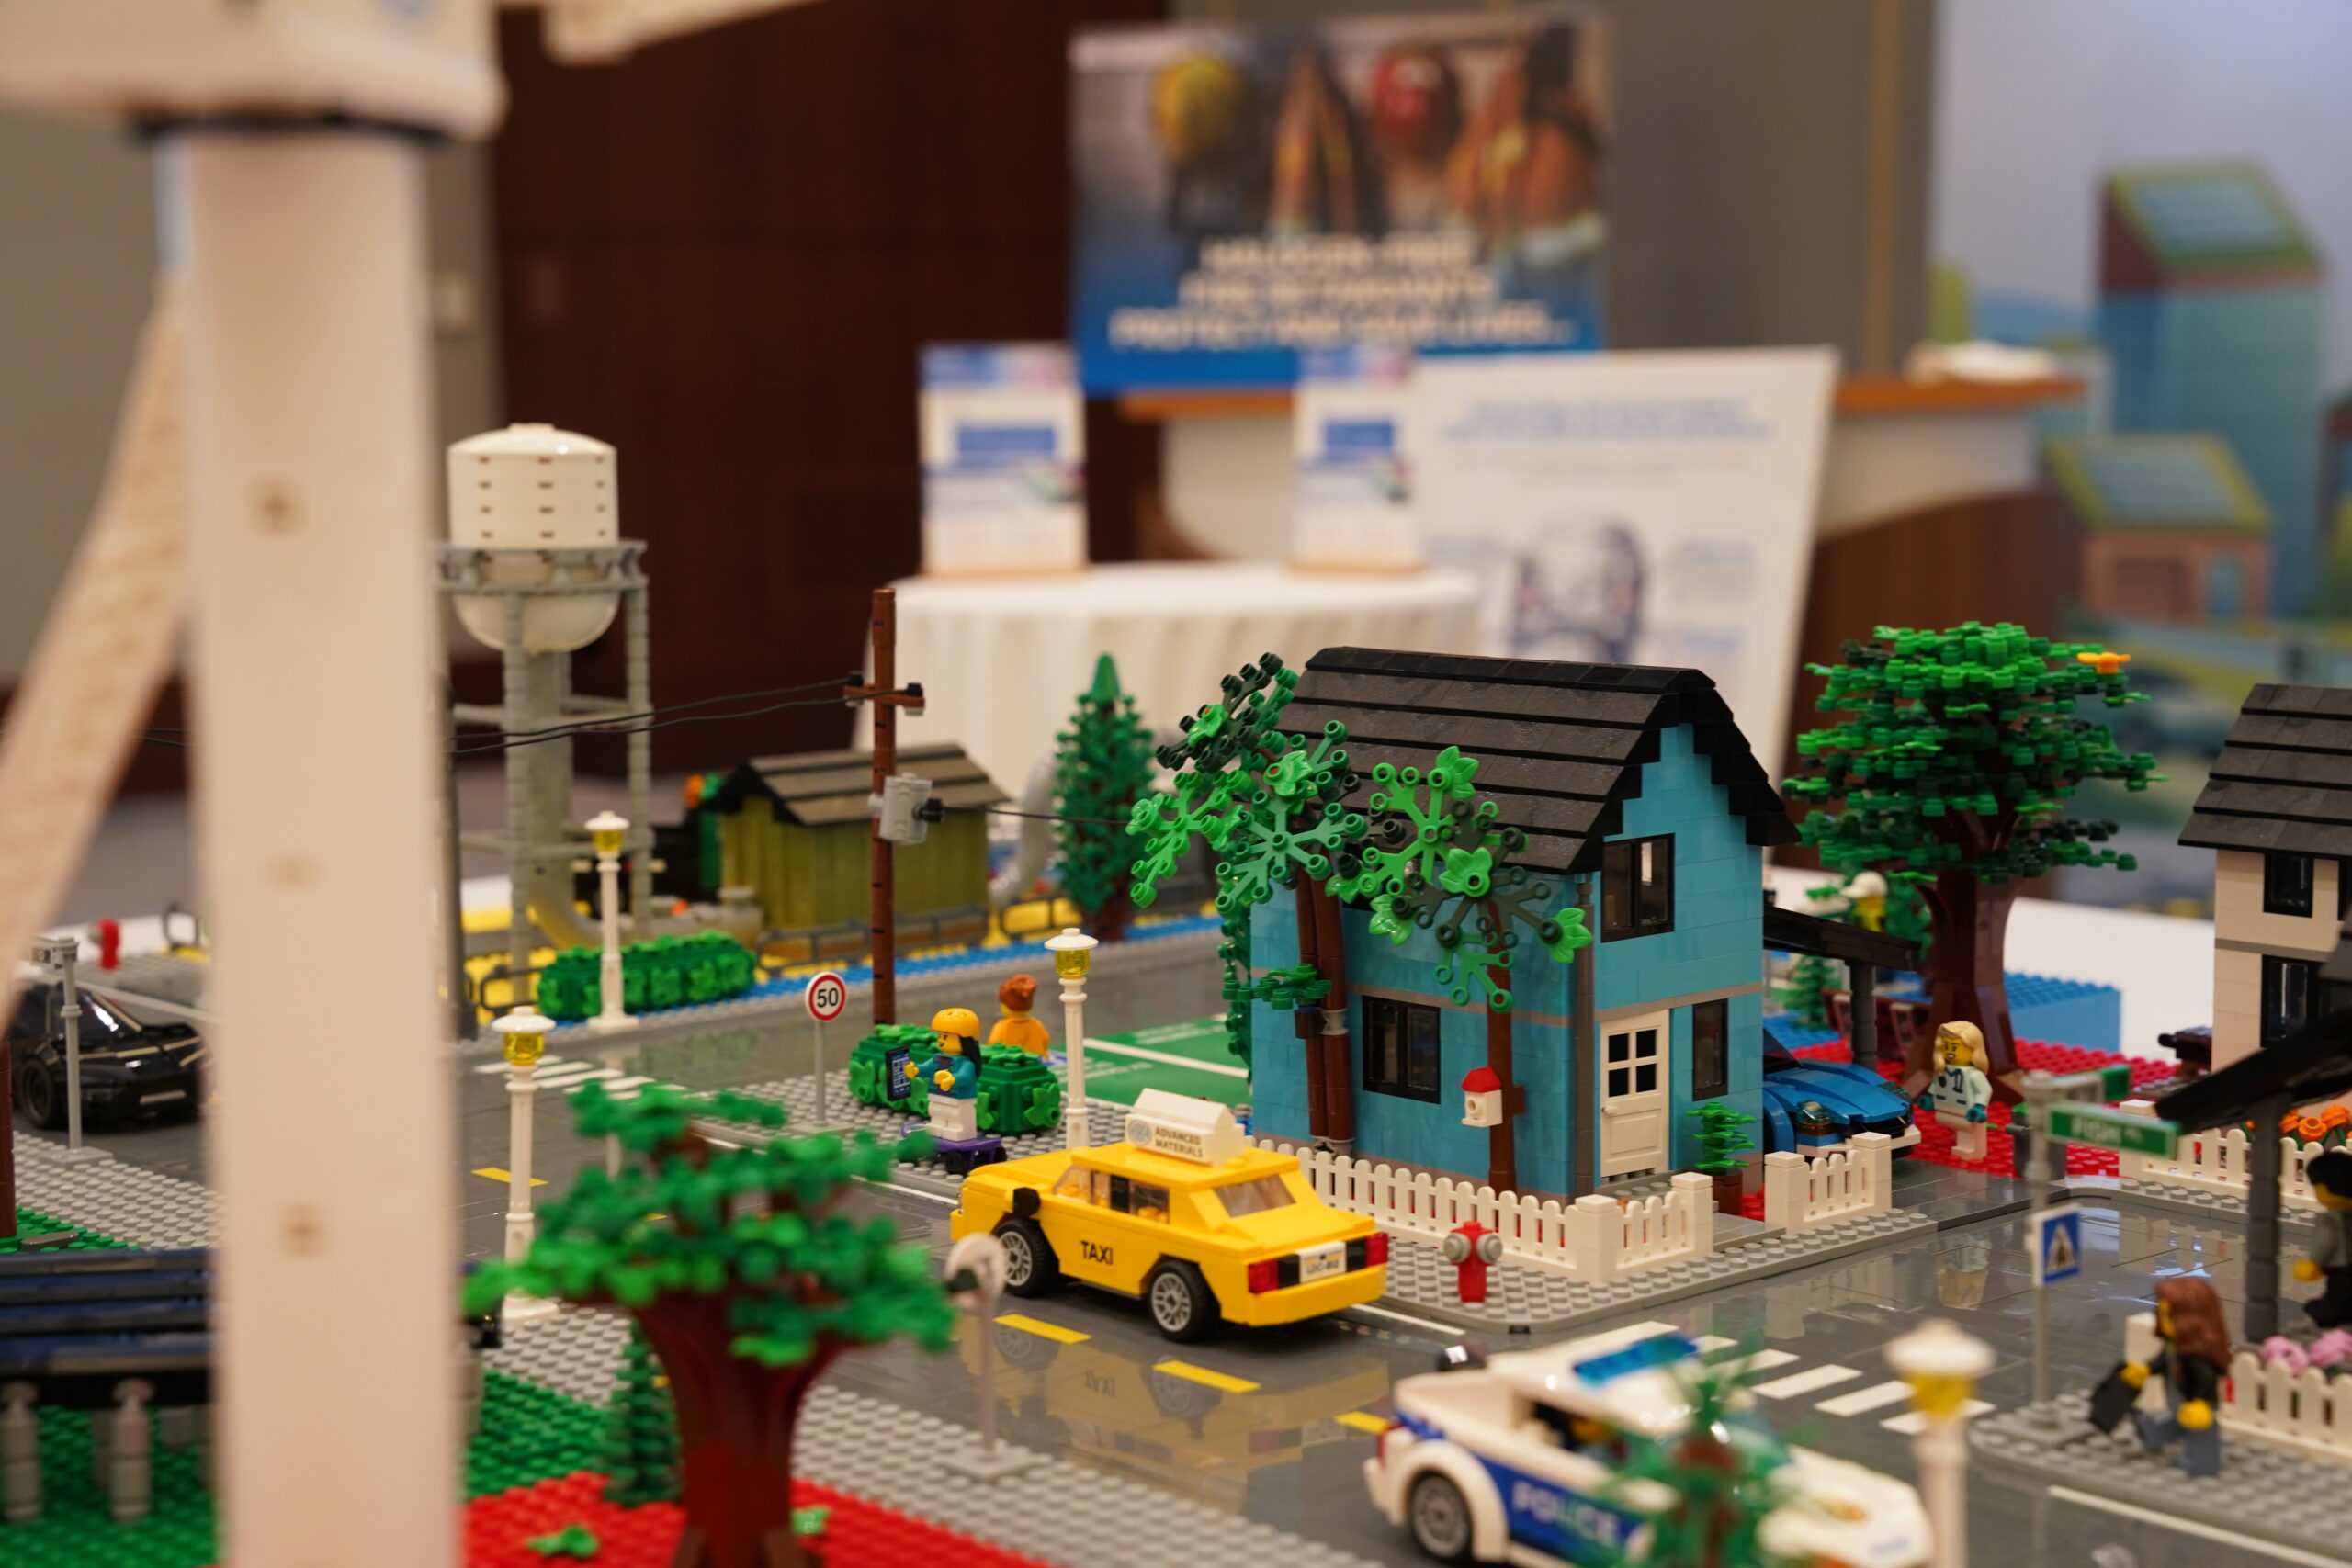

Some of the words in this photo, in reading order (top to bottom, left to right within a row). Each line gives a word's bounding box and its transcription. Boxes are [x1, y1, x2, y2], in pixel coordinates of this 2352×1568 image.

[817, 987, 839, 1008] 50
[1155, 1126, 1202, 1145] ADVANCED
[1155, 1138, 1203, 1158] MATERIALS
[1080, 1239, 1114, 1266] TAXI
[1512, 1480, 1621, 1550] POLICE
